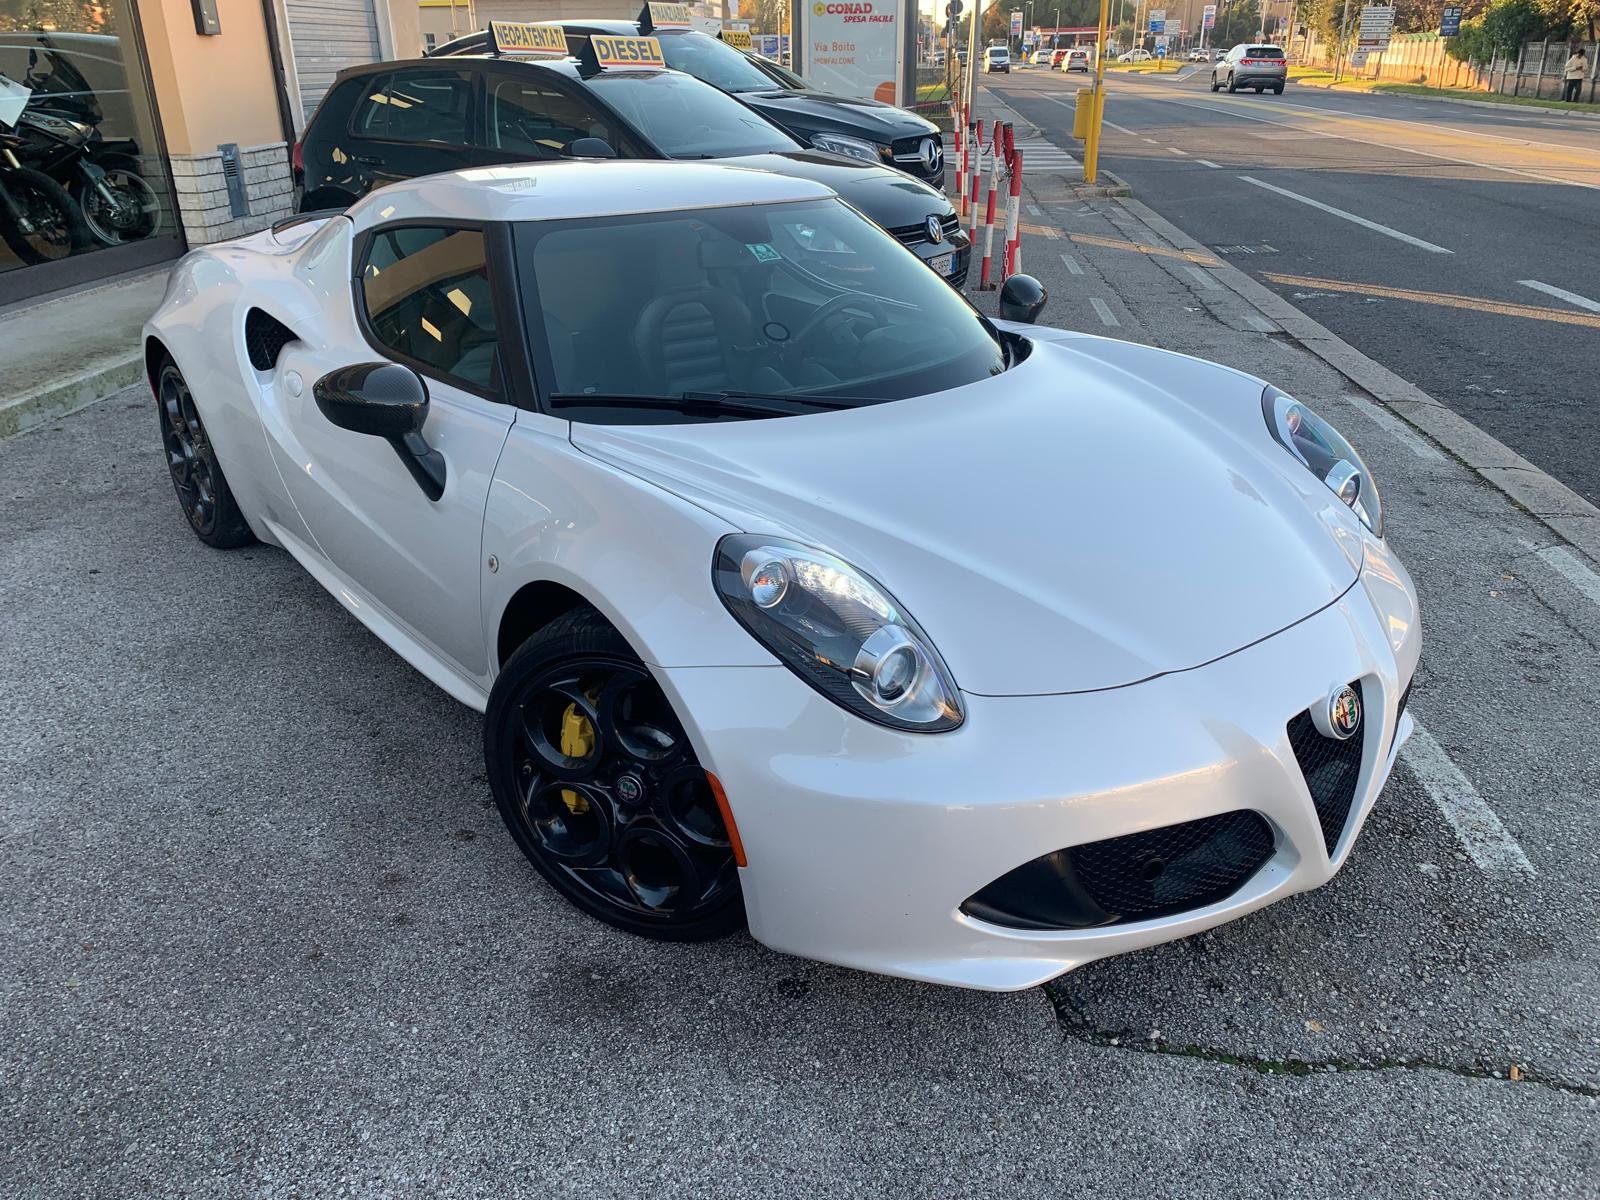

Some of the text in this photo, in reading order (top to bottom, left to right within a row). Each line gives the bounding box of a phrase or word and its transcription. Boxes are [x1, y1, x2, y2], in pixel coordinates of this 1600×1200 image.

[826, 2, 873, 14] CONAD
[843, 14, 895, 23] SPESA FACILE
[495, 25, 566, 48] NEOPATENTATI
[594, 39, 661, 61] DIESEL
[814, 41, 856, 52] Via Boito
[814, 56, 856, 65] MONFALCONE
